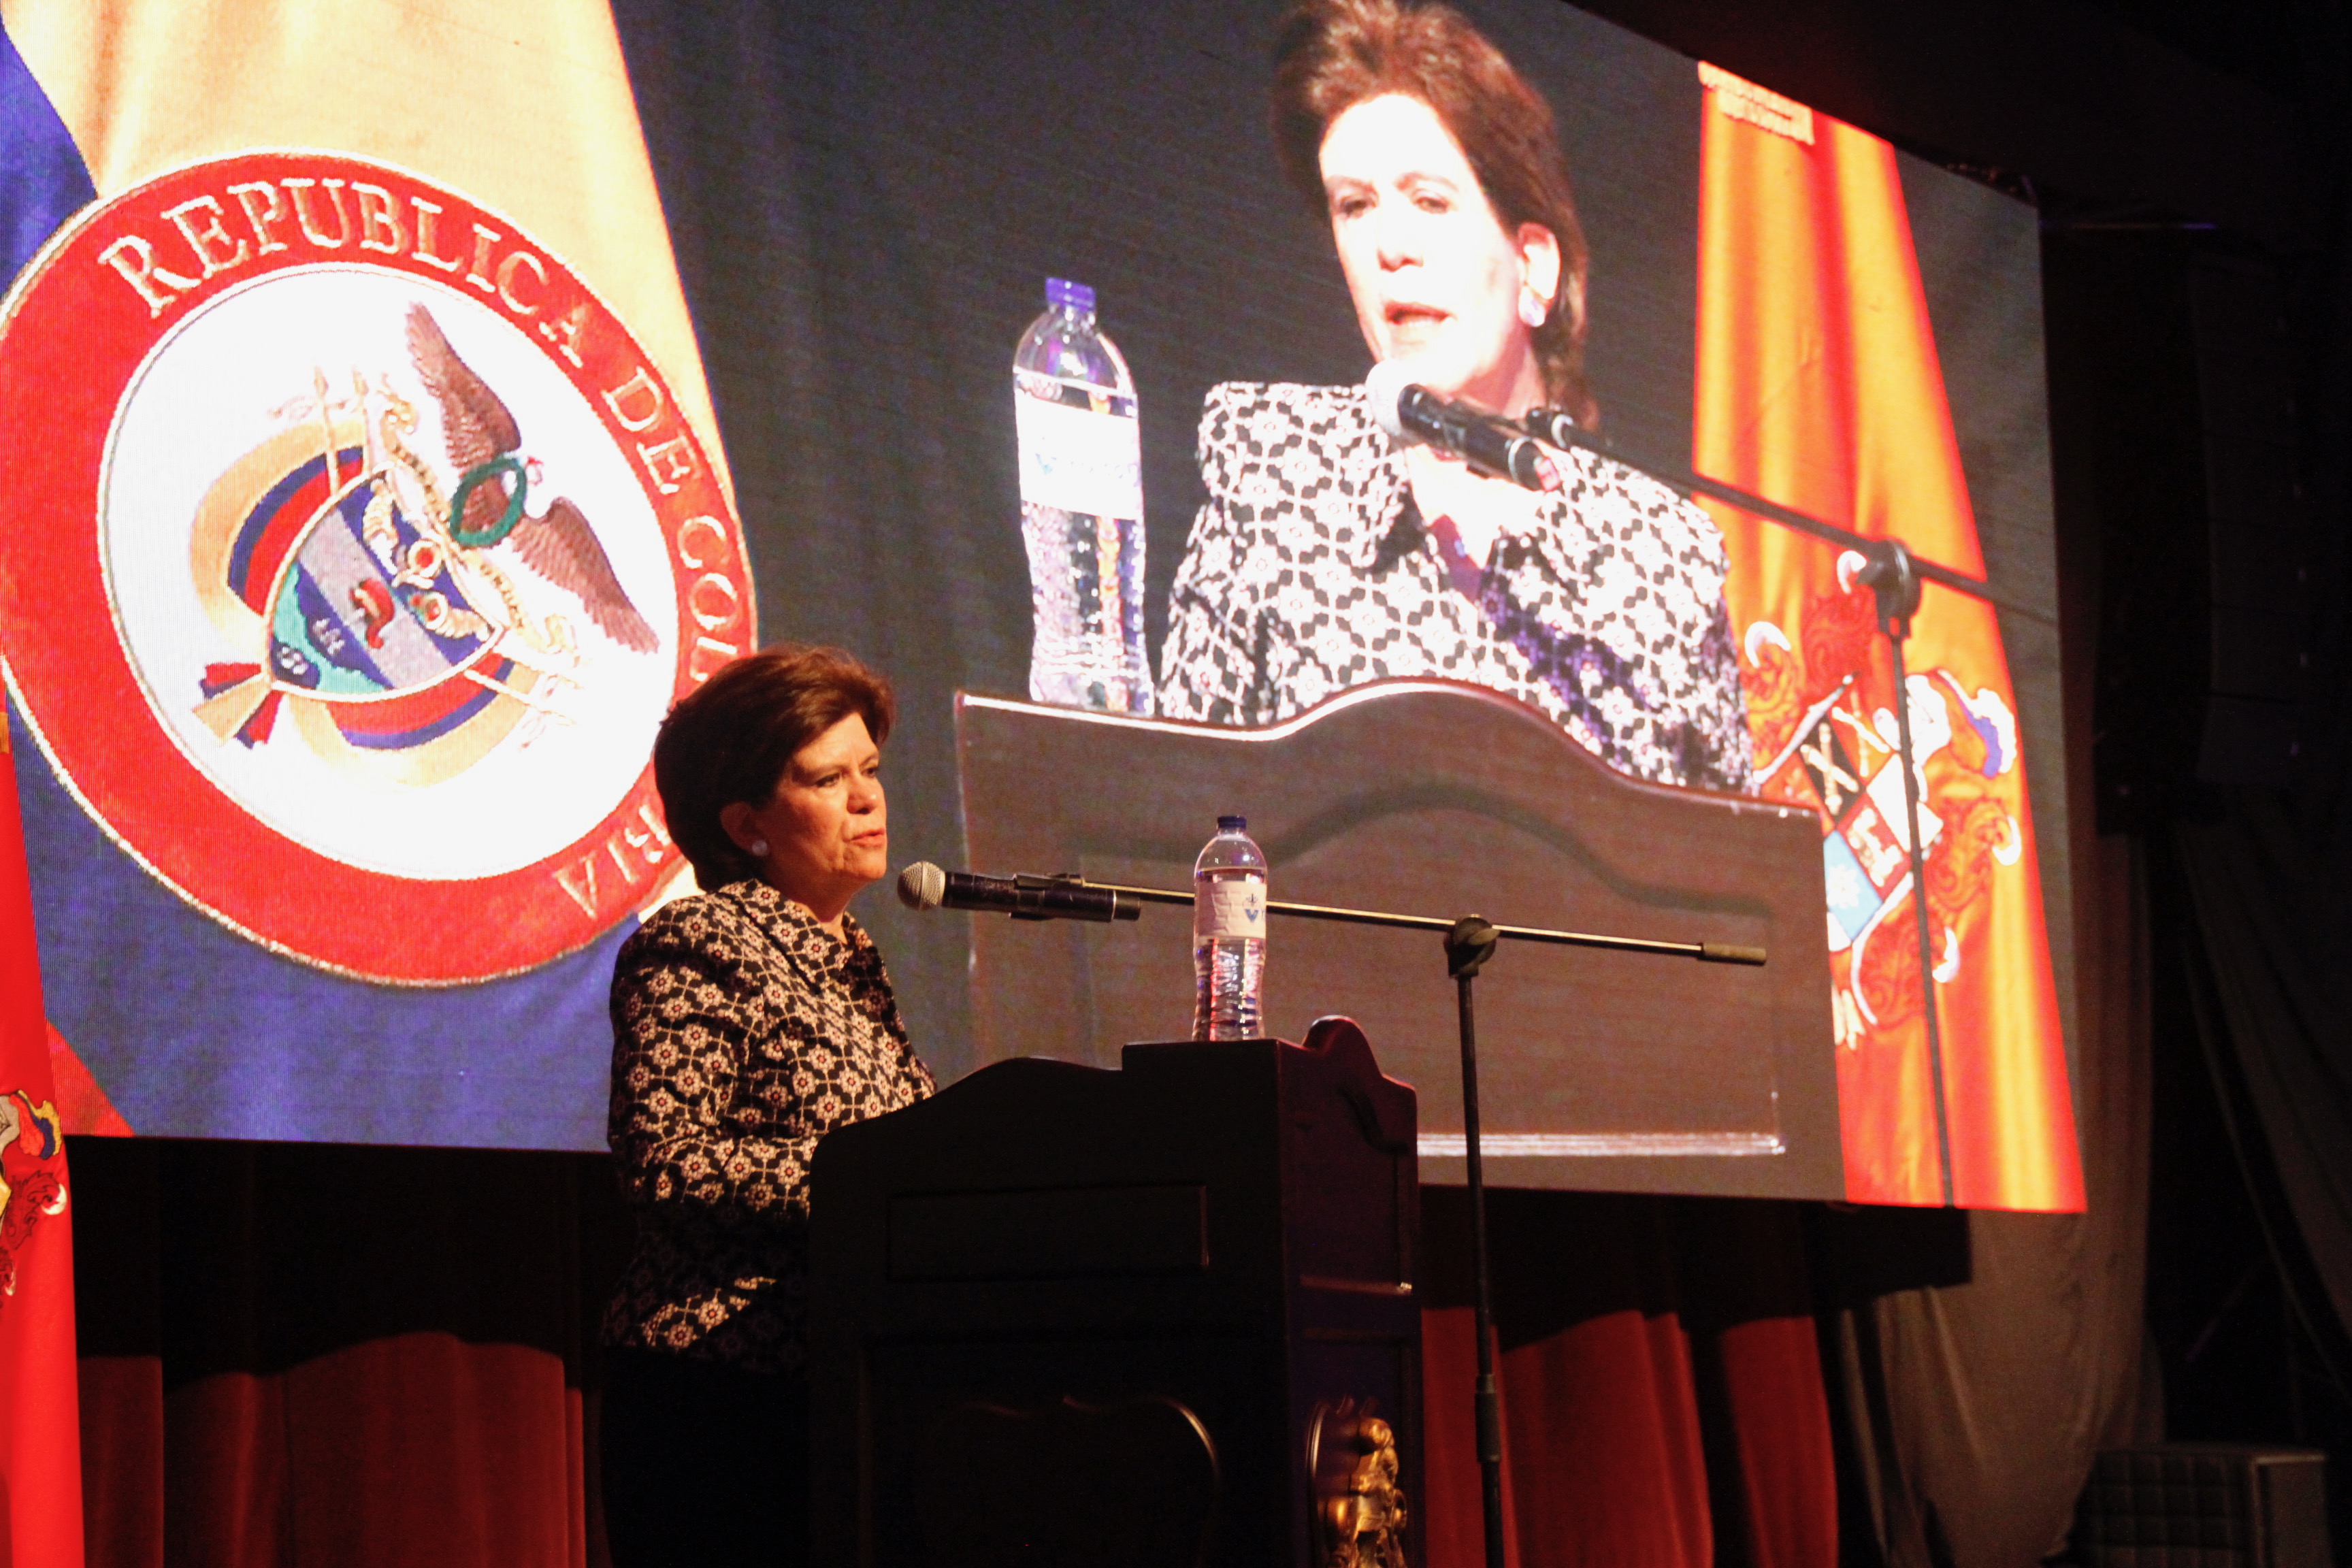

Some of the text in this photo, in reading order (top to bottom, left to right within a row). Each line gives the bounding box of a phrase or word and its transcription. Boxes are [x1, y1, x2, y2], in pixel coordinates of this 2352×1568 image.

[98, 177, 741, 919] REPUBLICA DE COLBIA
